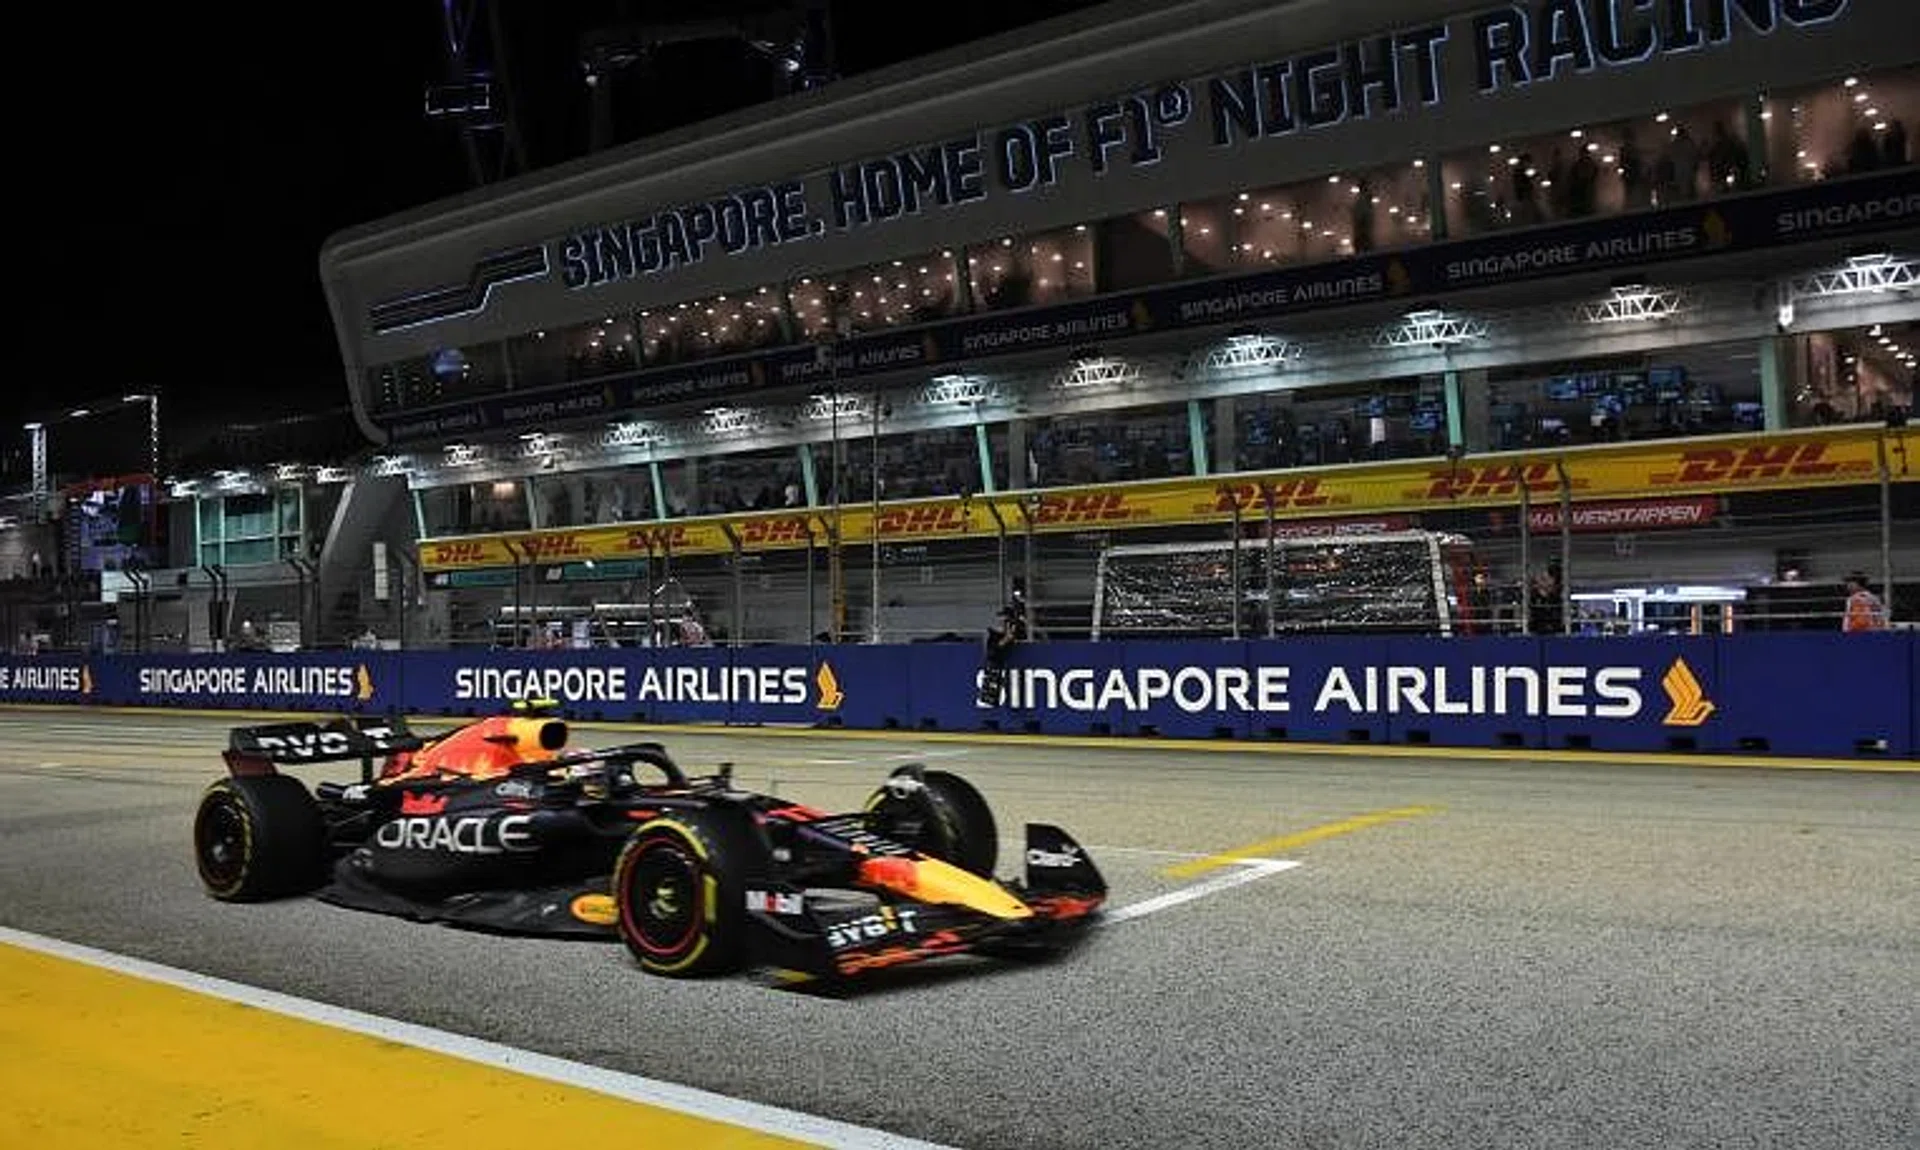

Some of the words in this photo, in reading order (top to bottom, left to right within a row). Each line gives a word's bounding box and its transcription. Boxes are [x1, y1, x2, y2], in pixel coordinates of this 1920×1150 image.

[832, 133, 987, 228] HOME
[999, 115, 1073, 193] OF
[1208, 24, 1448, 147] NIGHT
[1449, 243, 1578, 280] SINGAPORE
[1585, 226, 1696, 260] AIRLINES
[1293, 275, 1381, 301] AIRLINES
[1678, 443, 1838, 482] DHL
[1215, 479, 1328, 511] DHL
[1428, 462, 1563, 498] DHL
[879, 507, 967, 533] DHL
[1037, 496, 1129, 522] DHL
[1571, 504, 1703, 525] VERSTAPPEN
[743, 518, 810, 542] DHL
[436, 543, 485, 563] DHL
[522, 535, 579, 556] DHL
[12, 666, 80, 691] AIRLINES
[139, 667, 246, 695] SINGAPORE
[254, 667, 353, 697] AIRLINES
[455, 667, 626, 701] SINGAPORE
[639, 667, 808, 704] AIRLINES
[1314, 666, 1642, 718] AIRLINES
[377, 815, 538, 854] ORACLE
